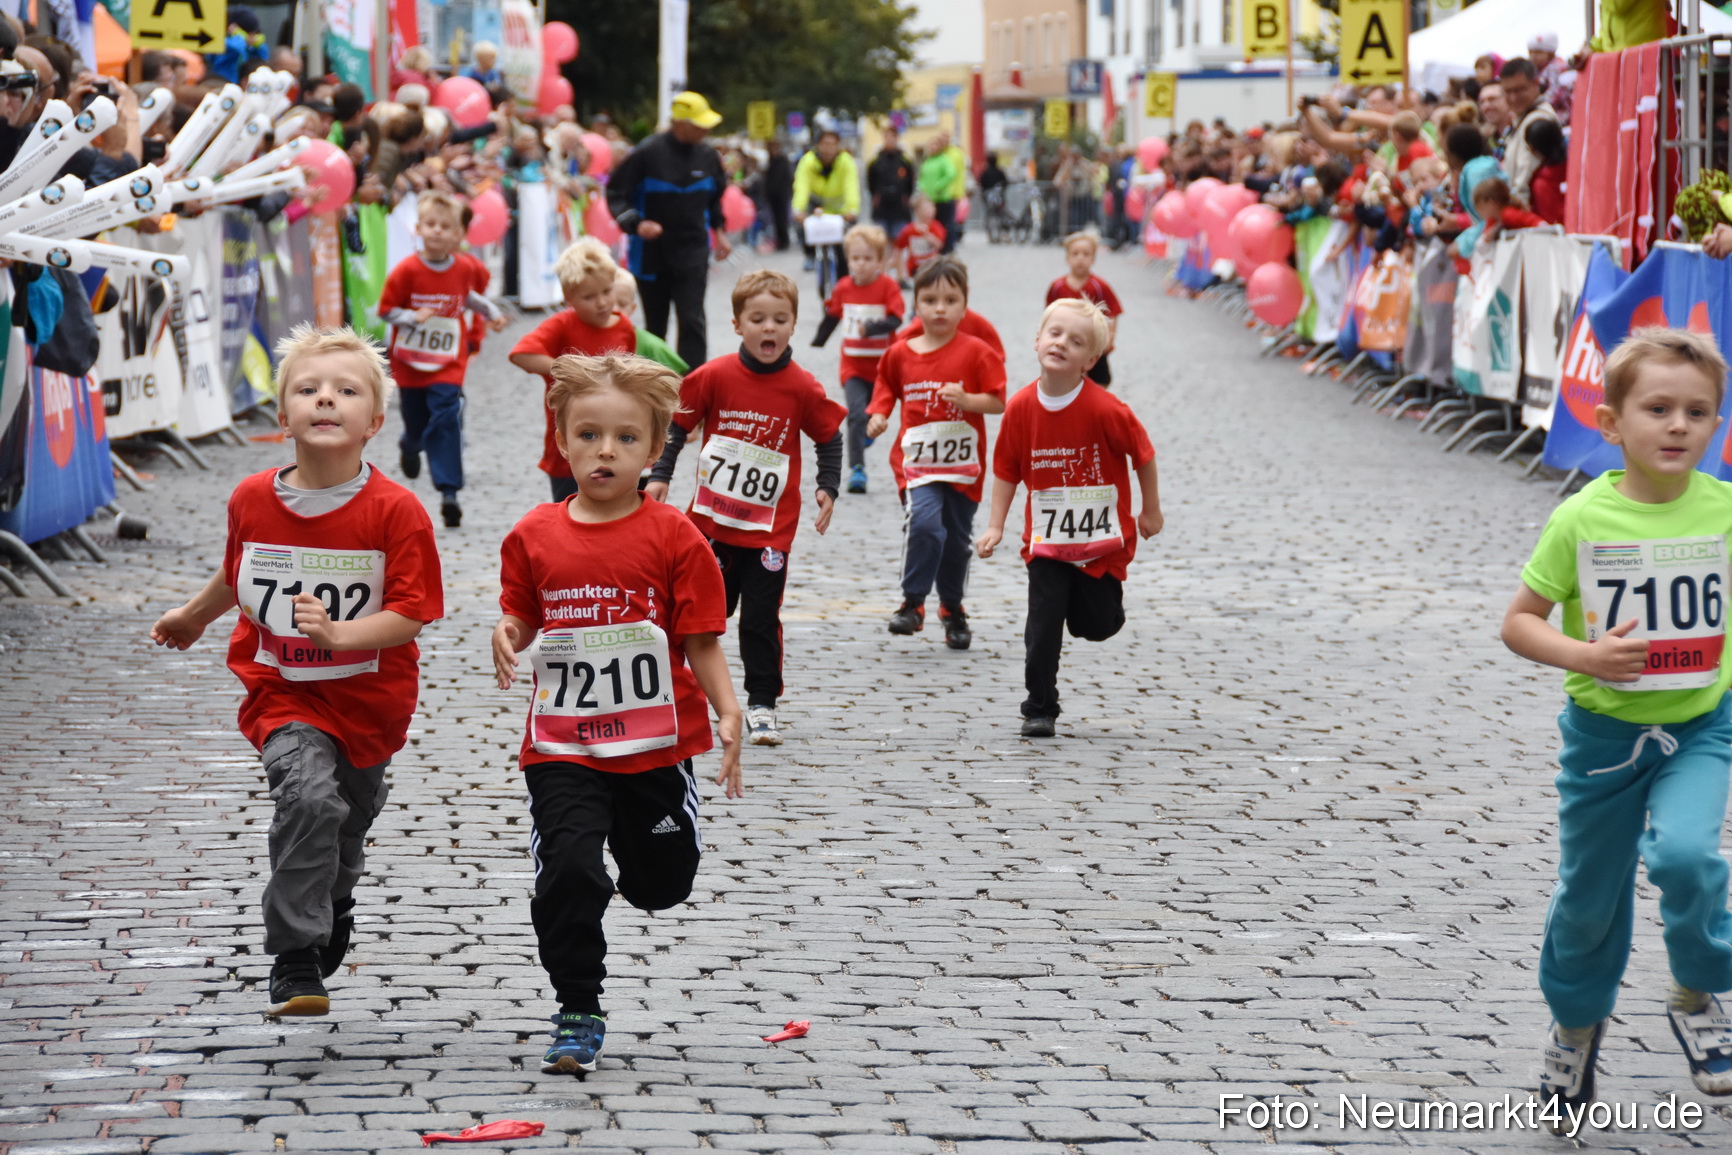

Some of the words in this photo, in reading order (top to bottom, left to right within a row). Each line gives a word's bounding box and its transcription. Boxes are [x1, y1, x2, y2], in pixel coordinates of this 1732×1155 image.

[1256, 6, 1278, 38] B
[1357, 12, 1393, 60] A
[404, 326, 454, 351] 7160
[911, 436, 972, 463] 7125
[709, 454, 779, 501] 7189
[1070, 488, 1113, 500] BOCK
[1041, 505, 1112, 539] 7444
[301, 552, 373, 571] BOCK
[1592, 557, 1643, 566] NeuerMarkt
[1653, 541, 1721, 562] BOCK
[250, 559, 294, 569] NeuerMarkt
[252, 577, 371, 629] 7192
[1597, 572, 1722, 631] 7106
[539, 643, 577, 652] NeuerMarkt
[583, 625, 656, 648] BOCK
[1645, 647, 1703, 669] orian
[546, 653, 660, 708] 7210
[663, 693, 670, 702] K
[577, 718, 626, 741] Eliah
[652, 825, 680, 834] adidas
